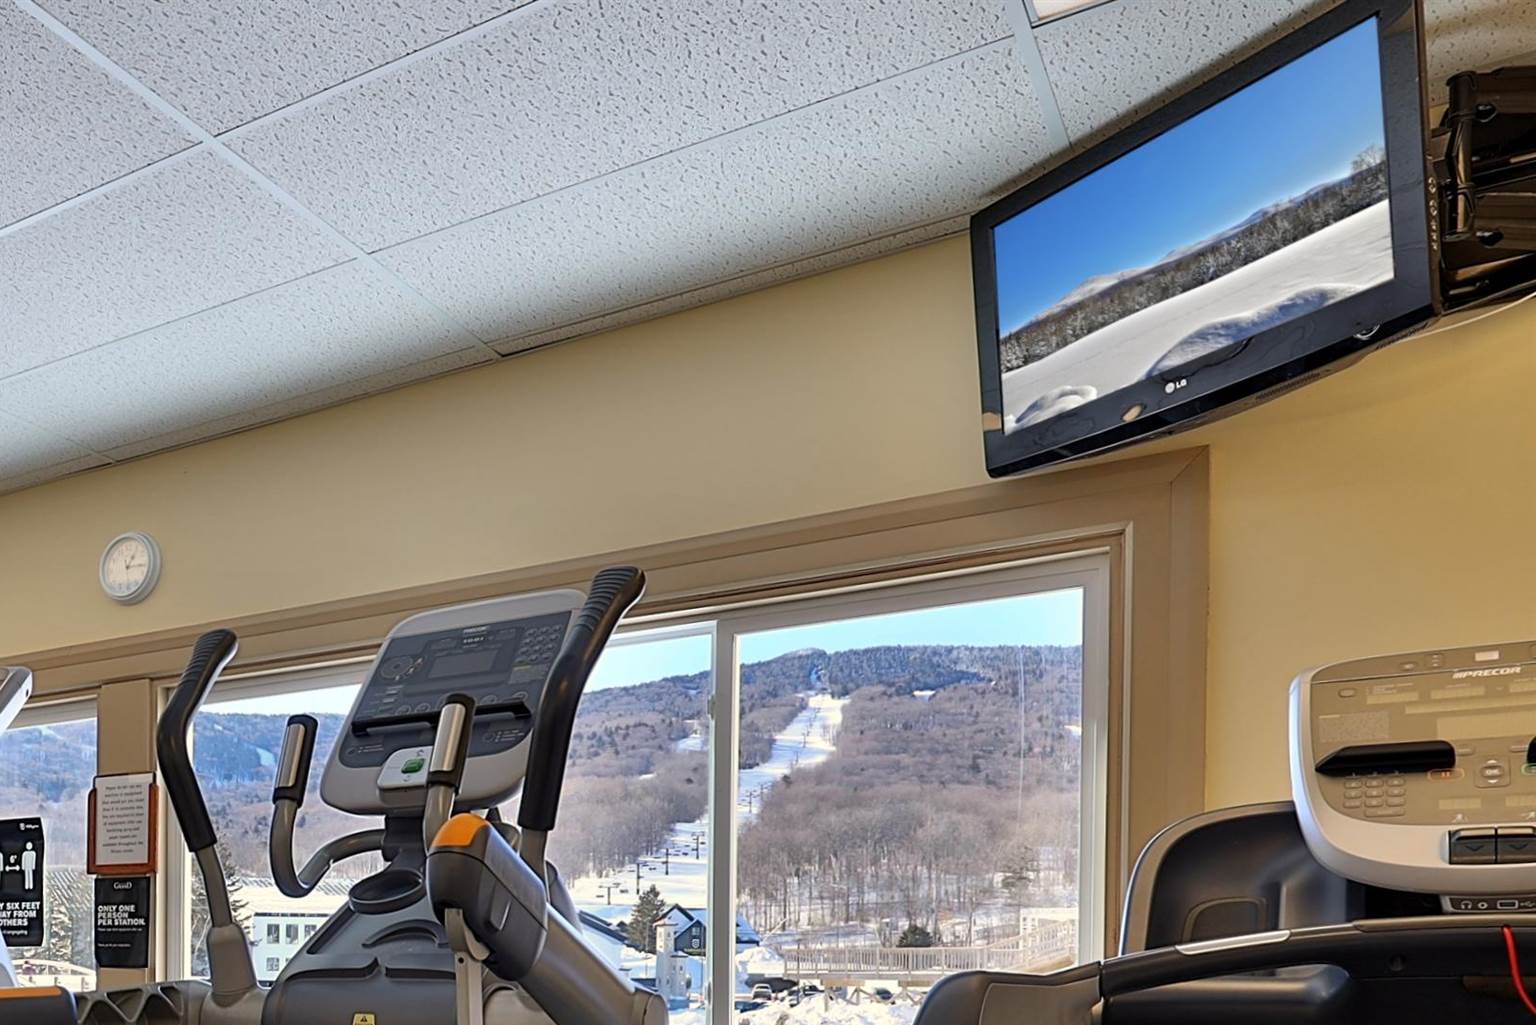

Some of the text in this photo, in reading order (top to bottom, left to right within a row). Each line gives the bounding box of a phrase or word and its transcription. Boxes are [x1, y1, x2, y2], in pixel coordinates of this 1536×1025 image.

[1176, 378, 1187, 389] LG
[1458, 666, 1522, 679] PRECOR
[6, 902, 20, 910] SIX
[21, 901, 41, 910] FEET
[13, 910, 37, 918] FROM
